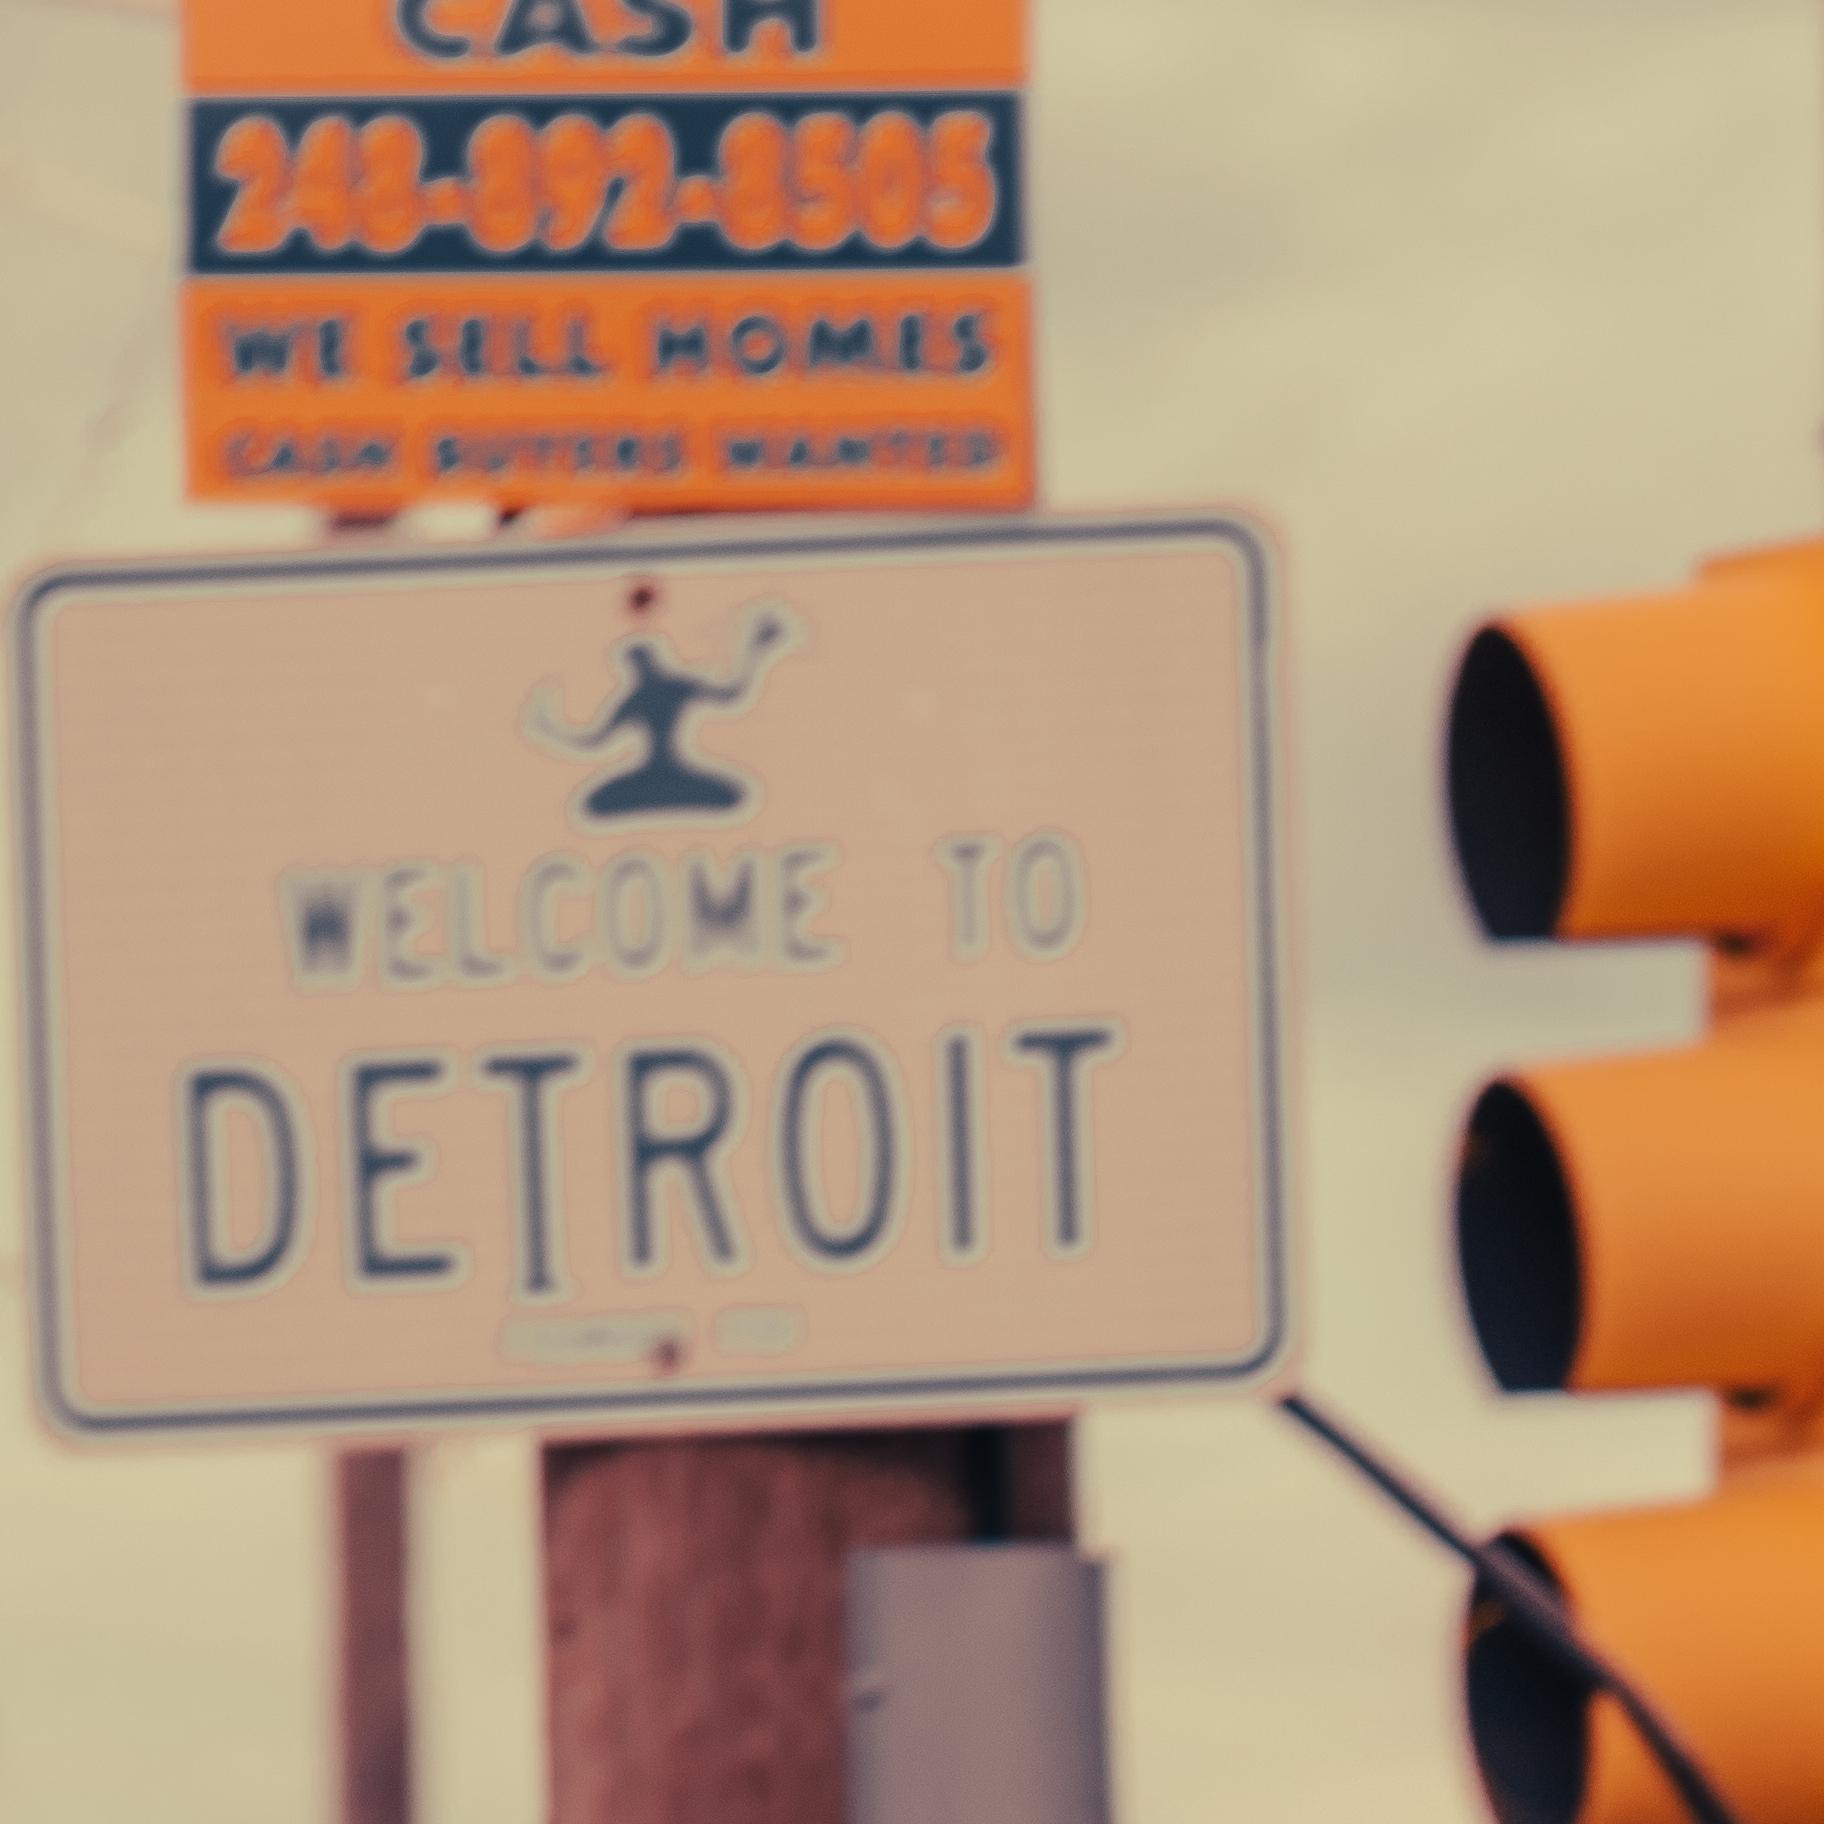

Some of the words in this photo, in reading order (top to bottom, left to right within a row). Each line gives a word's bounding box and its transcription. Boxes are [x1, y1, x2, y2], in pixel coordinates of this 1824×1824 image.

[394, 0, 822, 58] CASH
[224, 318, 350, 376] WE
[400, 316, 604, 376] SELL
[654, 312, 996, 374] HOMES
[726, 426, 1002, 474] WANTED
[284, 848, 842, 986] WELCOME
[938, 836, 1086, 958] TO
[188, 1026, 1114, 1292] DETROIT
